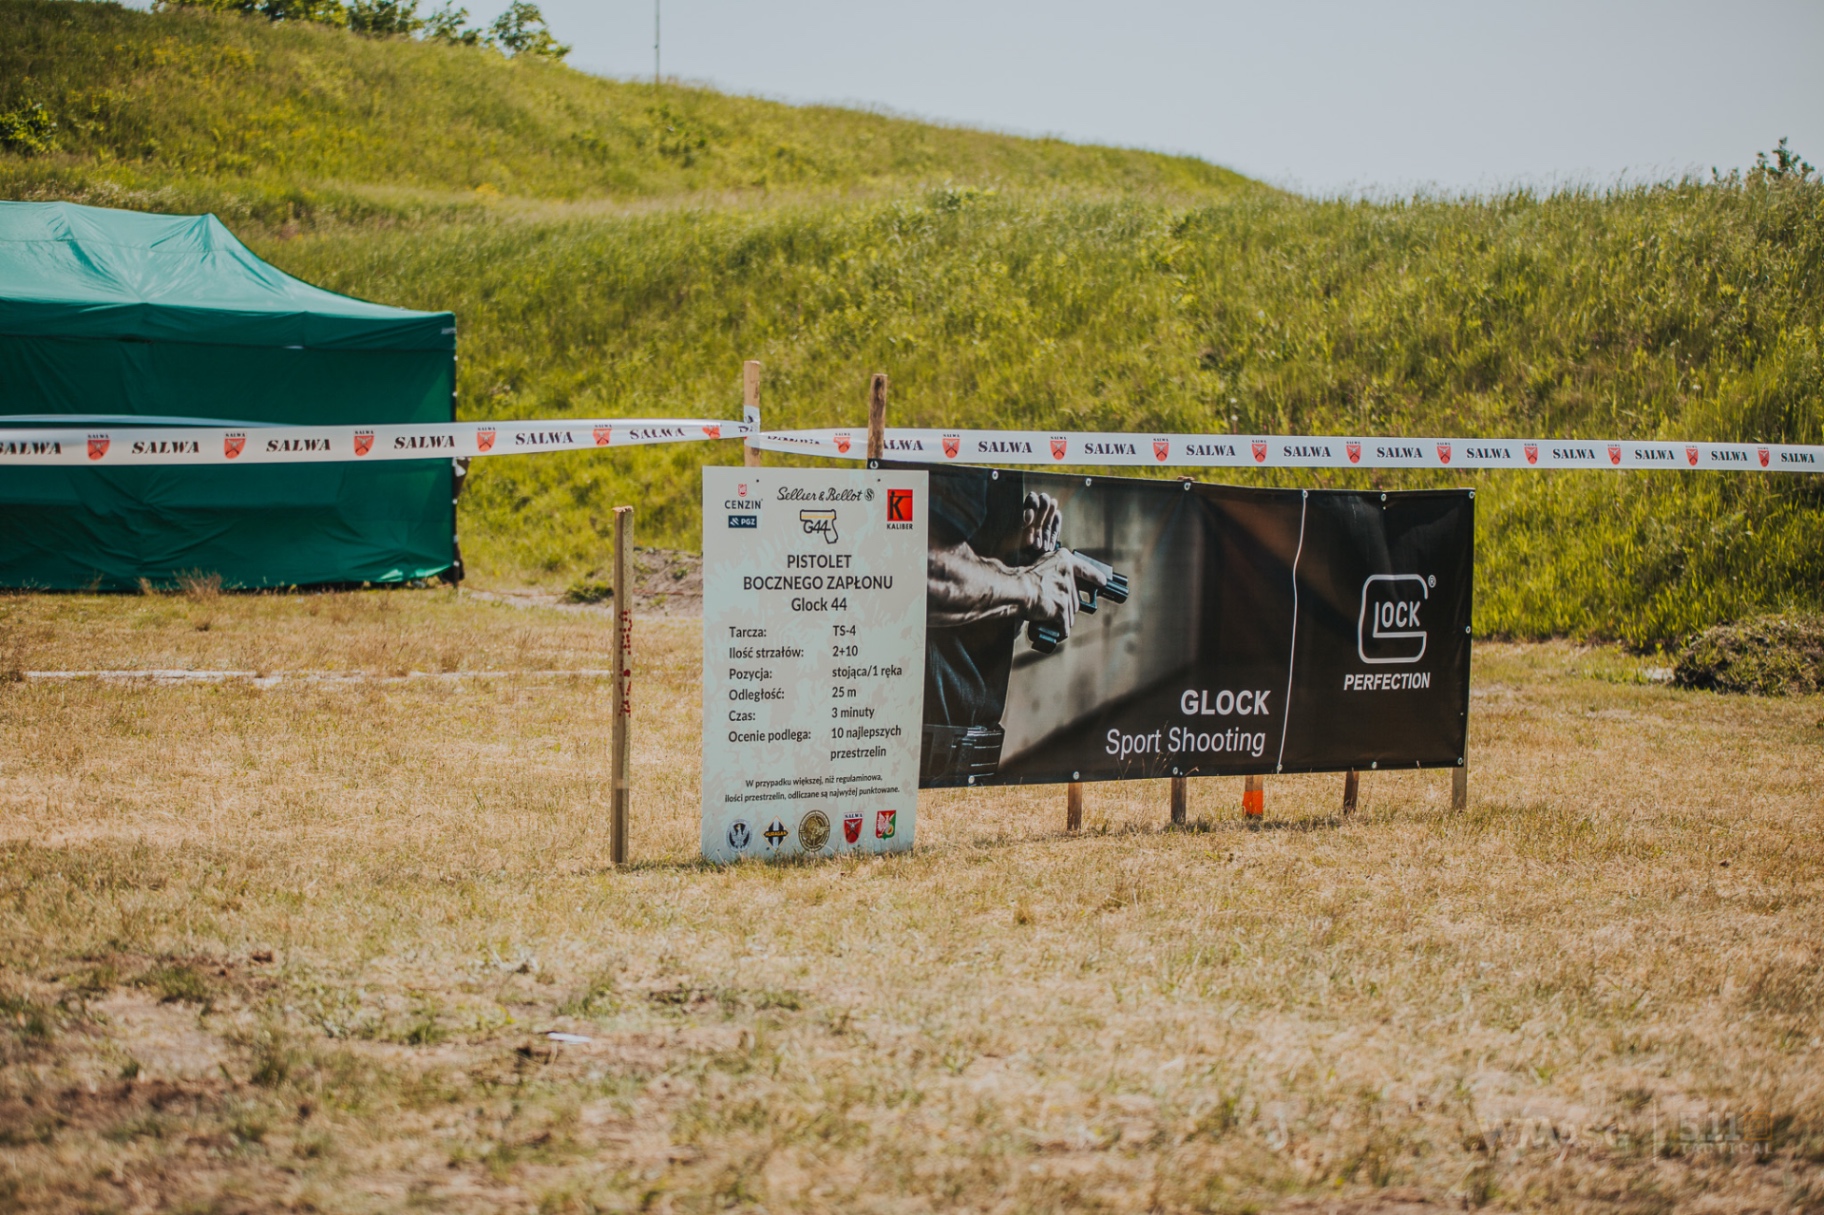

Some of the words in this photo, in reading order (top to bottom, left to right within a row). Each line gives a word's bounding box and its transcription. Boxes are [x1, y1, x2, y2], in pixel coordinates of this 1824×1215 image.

[132, 441, 200, 454] SALWA
[266, 439, 331, 452] SALWA
[394, 435, 455, 449] SALWA
[515, 431, 574, 445] SALWA
[629, 428, 686, 440] SALWA
[978, 441, 1033, 453] SALWA
[1085, 442, 1137, 455] SALWA
[1186, 444, 1236, 456] SALWA
[1283, 445, 1332, 457] SALWA
[1376, 447, 1423, 459] SALWA
[1466, 448, 1511, 459] SALWA
[1552, 448, 1595, 459] SALWA
[1634, 449, 1675, 460] SALWA
[1711, 450, 1748, 461] SALWA
[1781, 452, 1815, 463] SALWA
[777, 486, 816, 501] Sellier
[818, 491, 825, 501] &
[825, 487, 862, 501] Bellot
[724, 500, 761, 509] CENZIN
[803, 520, 832, 534] G44
[787, 554, 852, 568] PISTOLET
[743, 576, 824, 590] BOCZNEGO
[826, 576, 894, 590] ZAPŁONU
[791, 597, 828, 611] Glock
[831, 597, 848, 611] 44
[729, 626, 767, 638] Tarcza:
[832, 625, 857, 636] TS-4
[729, 647, 754, 658] Ilość
[756, 647, 804, 658] strzałów:
[832, 645, 858, 657] 2+10
[729, 668, 773, 682] Pozycja:
[831, 665, 878, 680] stojąca/1
[880, 665, 902, 678] ręka
[1344, 672, 1431, 691] PERFECTION
[728, 688, 785, 702] Odległość:
[831, 687, 845, 698] 25
[847, 689, 857, 698] m
[1180, 689, 1271, 715] GLOCK
[728, 710, 756, 721] Czas:
[831, 708, 838, 718] 3
[840, 707, 875, 720] minuty
[728, 730, 766, 743] Ocenie
[768, 729, 812, 744] podlega:
[831, 727, 844, 739] 10
[845, 725, 902, 741] najlepszych
[1105, 728, 1162, 760] Sport
[1167, 726, 1266, 758] Shooting
[830, 746, 887, 762] przestrzelin
[755, 778, 792, 788] przypadku
[792, 776, 823, 786] większej,
[725, 793, 743, 803] ilości
[744, 791, 787, 803] przestrzelin,
[788, 791, 819, 799] odliczane
[820, 791, 828, 799] są
[829, 788, 858, 798] najwyżej
[858, 786, 900, 796] punktowane.
